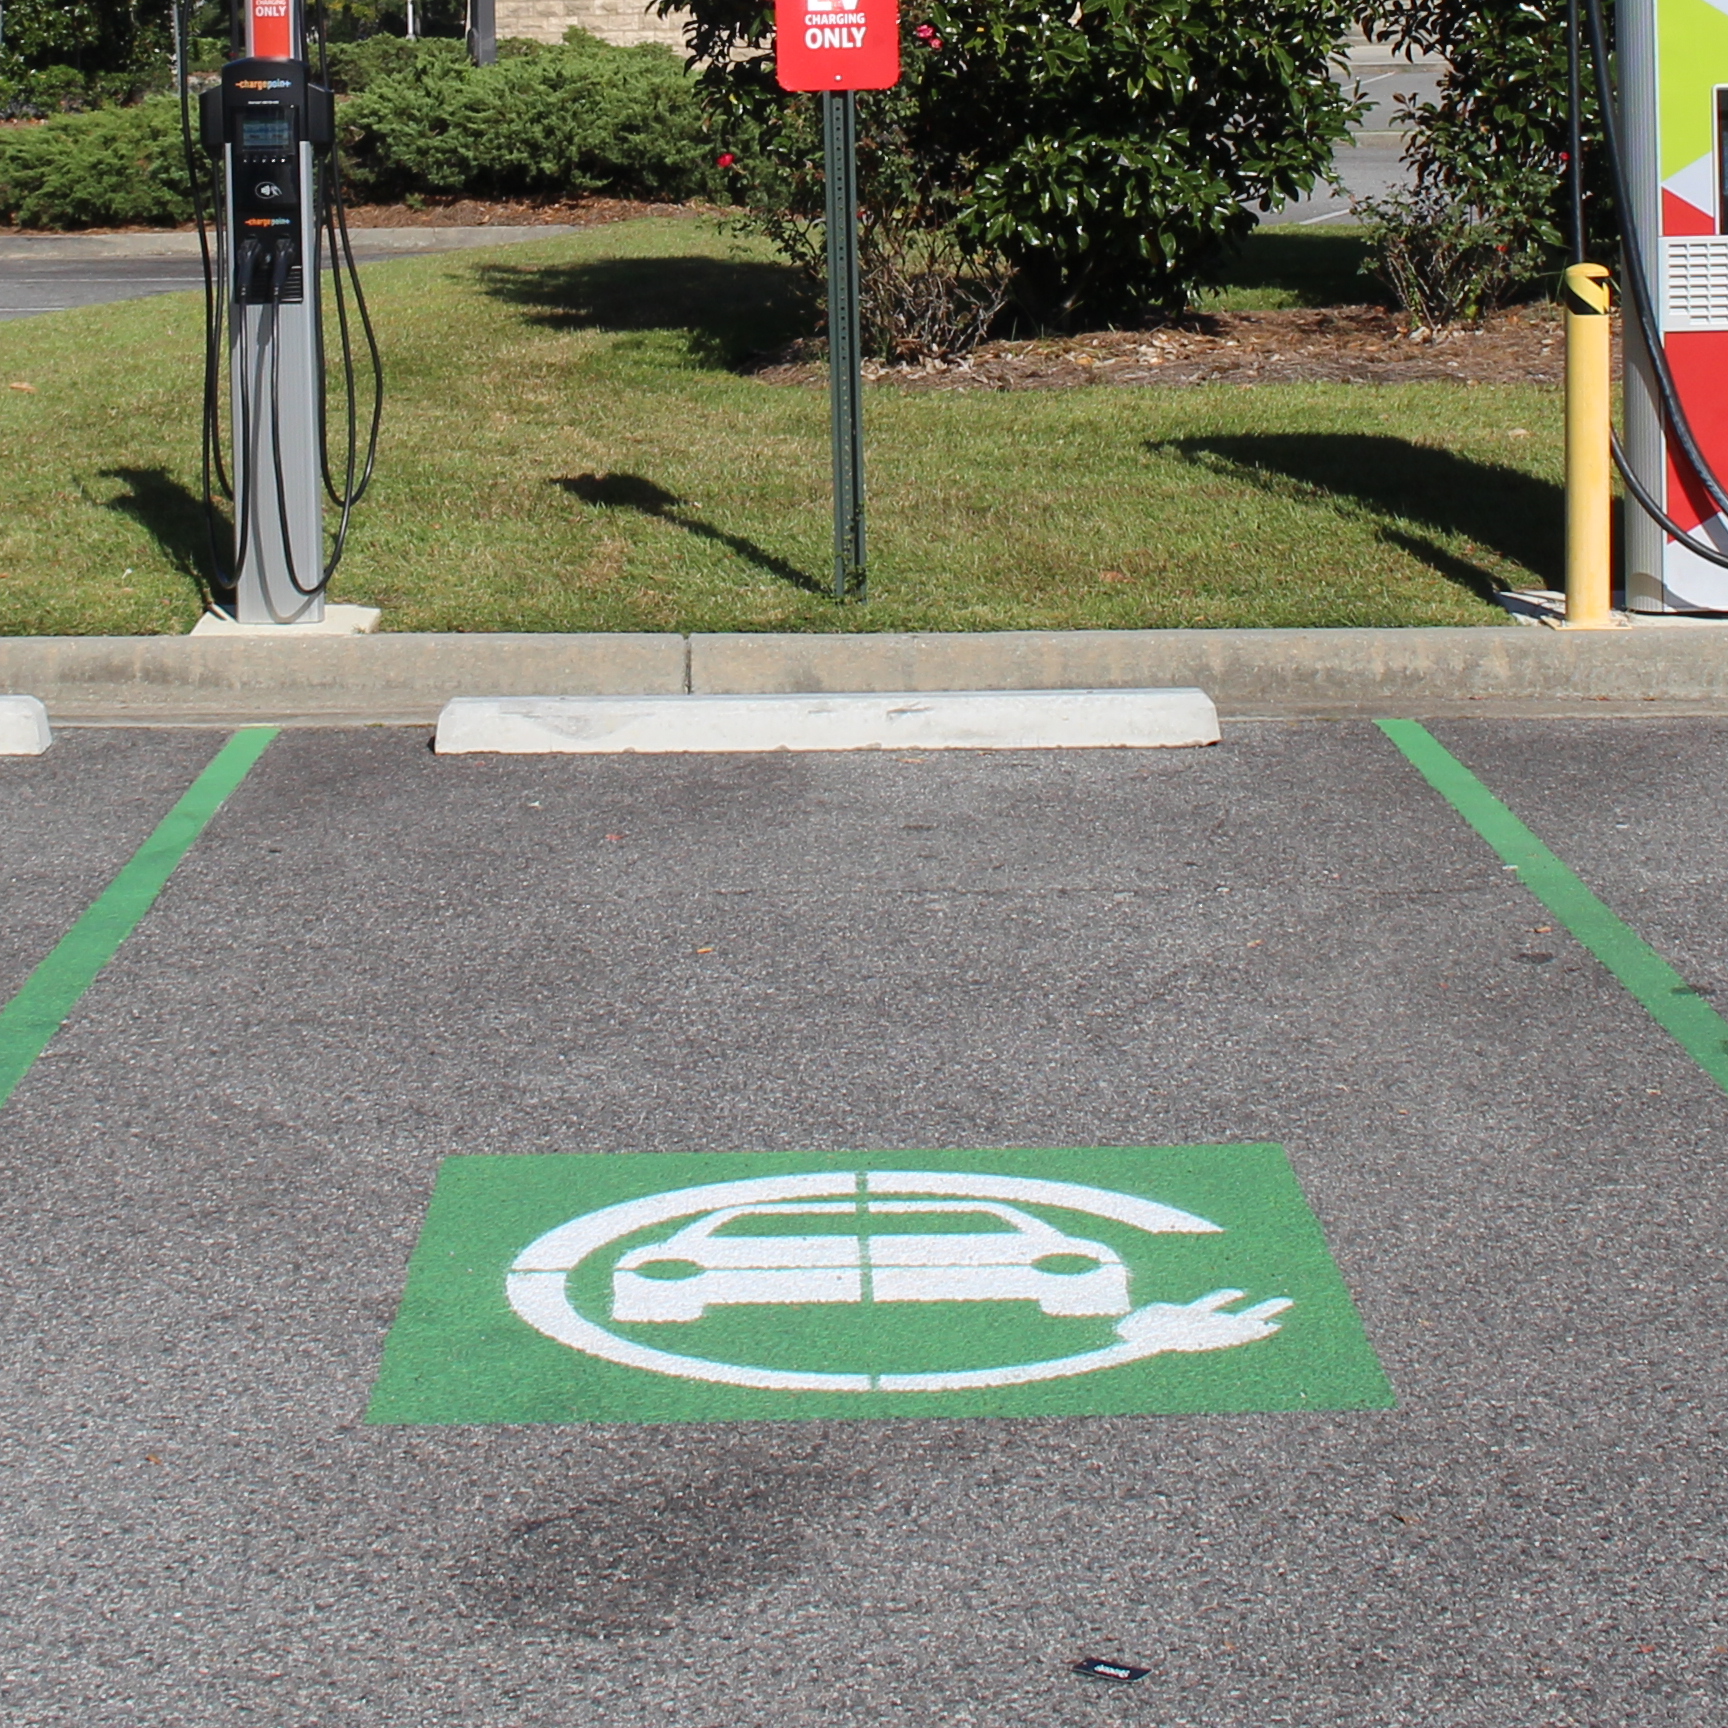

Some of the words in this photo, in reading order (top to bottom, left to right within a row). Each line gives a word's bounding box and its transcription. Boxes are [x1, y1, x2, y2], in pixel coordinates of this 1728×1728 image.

[255, 5, 287, 17] ONLY
[805, 13, 865, 25] CHARGING
[805, 27, 866, 49] ONLY
